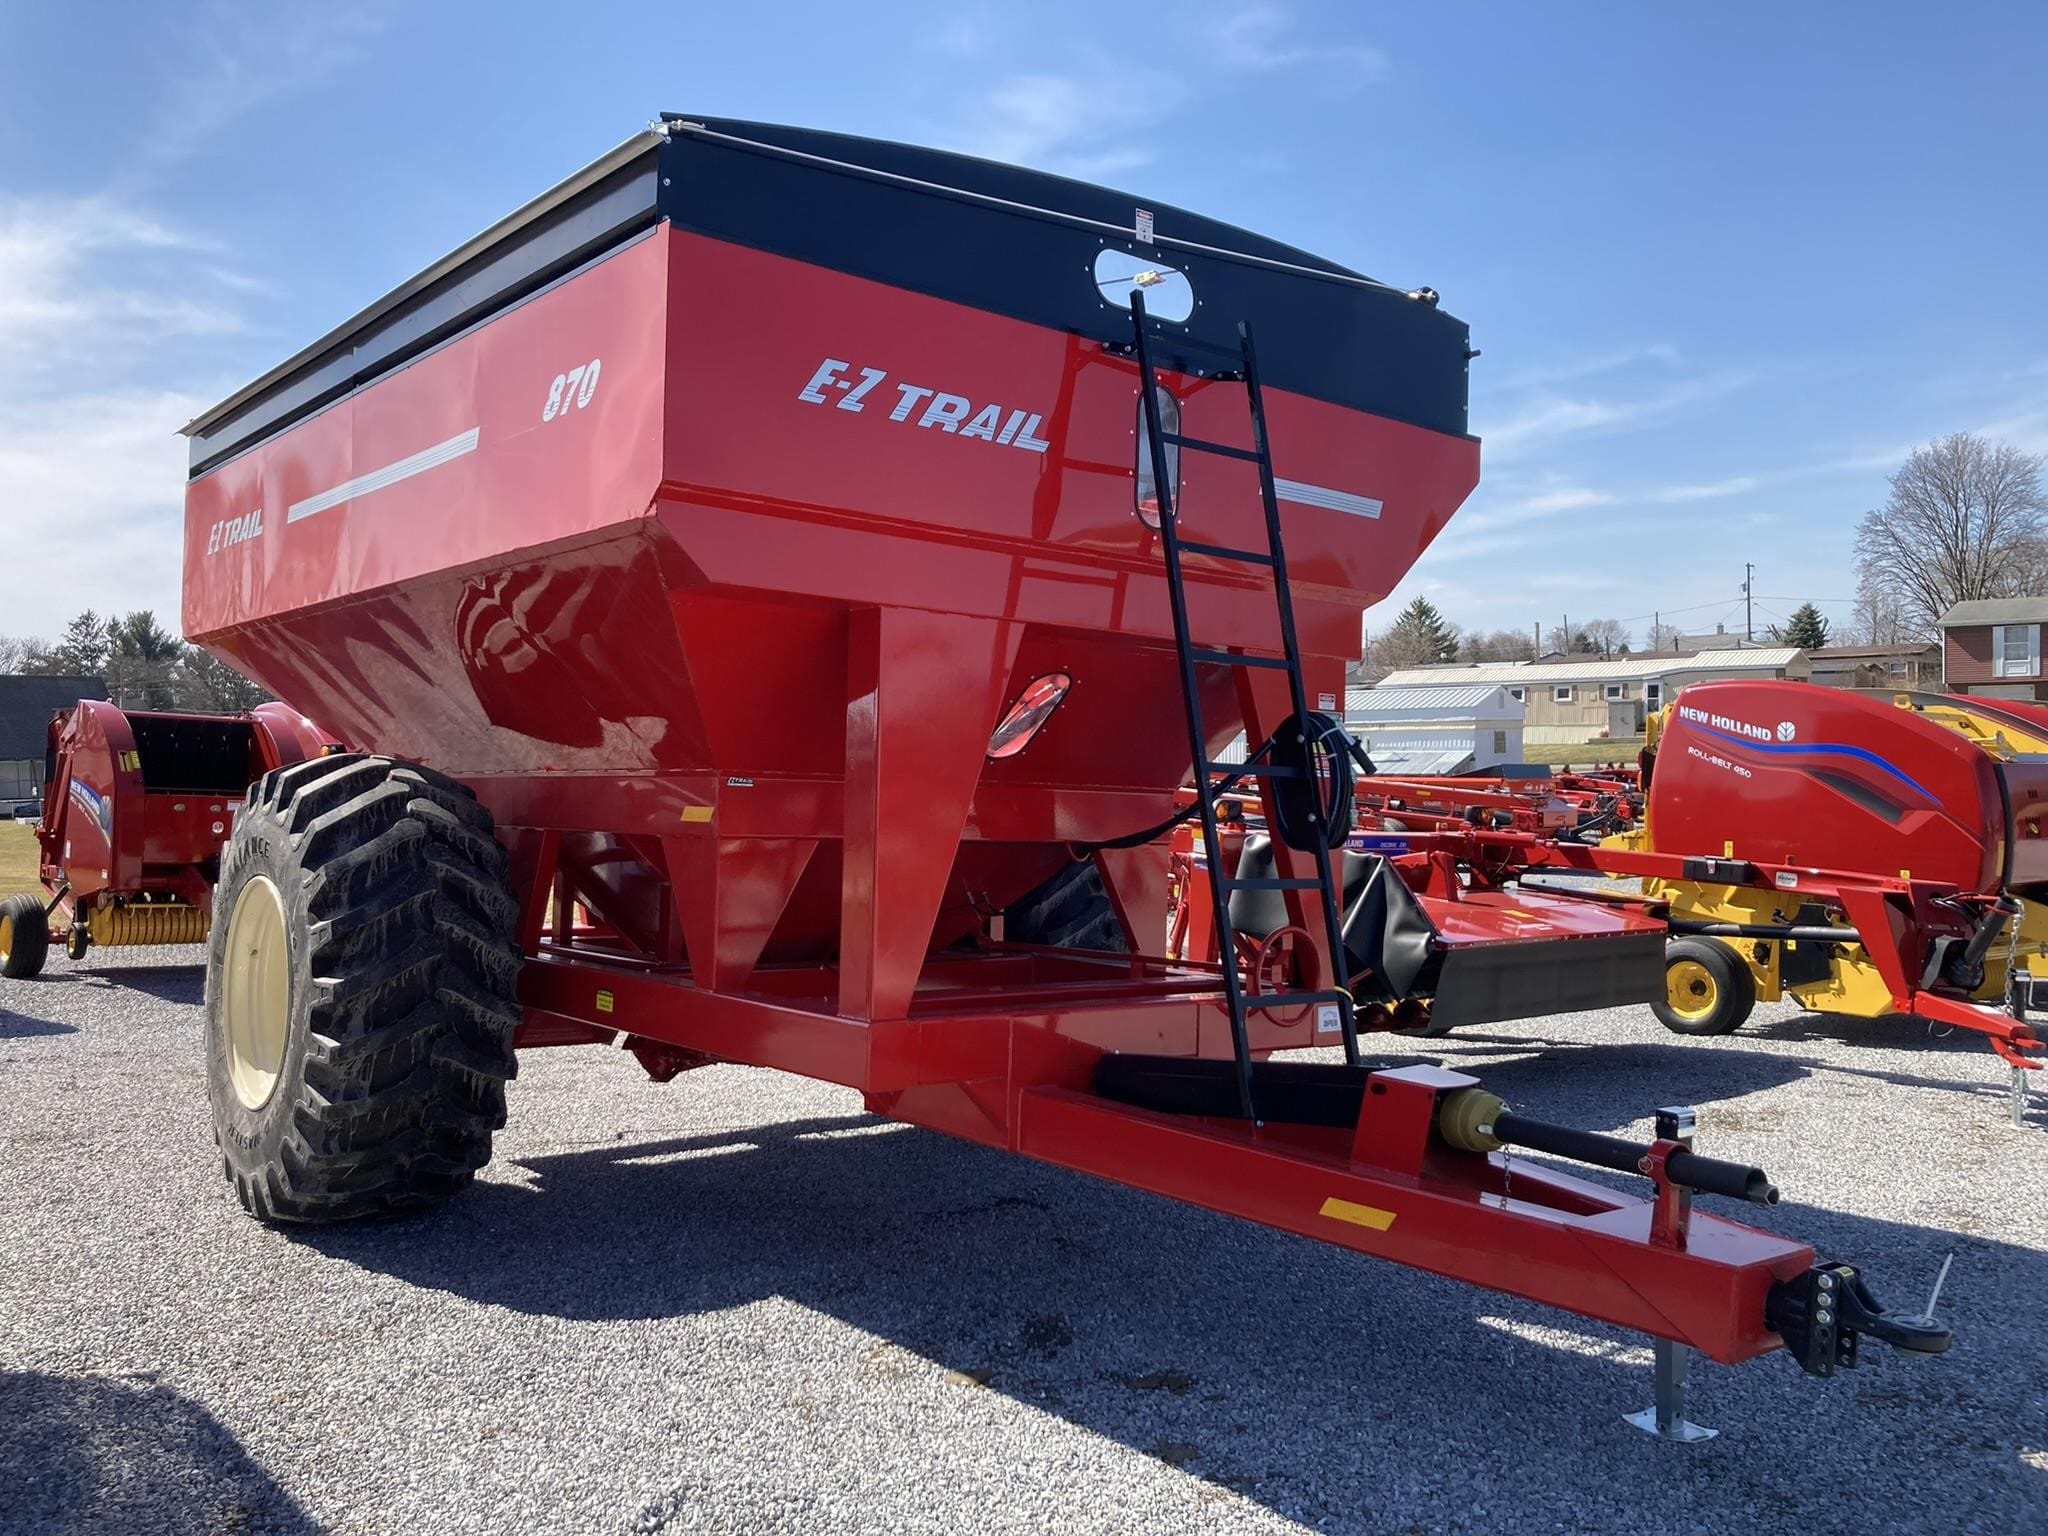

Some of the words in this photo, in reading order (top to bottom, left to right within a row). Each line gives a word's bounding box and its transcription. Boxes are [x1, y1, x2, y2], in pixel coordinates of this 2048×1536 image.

[541, 358, 601, 422] 870
[797, 357, 887, 413] E-Z
[889, 382, 1050, 454] TRAIL
[223, 508, 263, 549] TRAIL
[1680, 705, 1708, 724] NEW
[1711, 714, 1772, 741] HOLLAND
[1688, 746, 1732, 770] ROLL-BELT
[1733, 765, 1752, 778] 450
